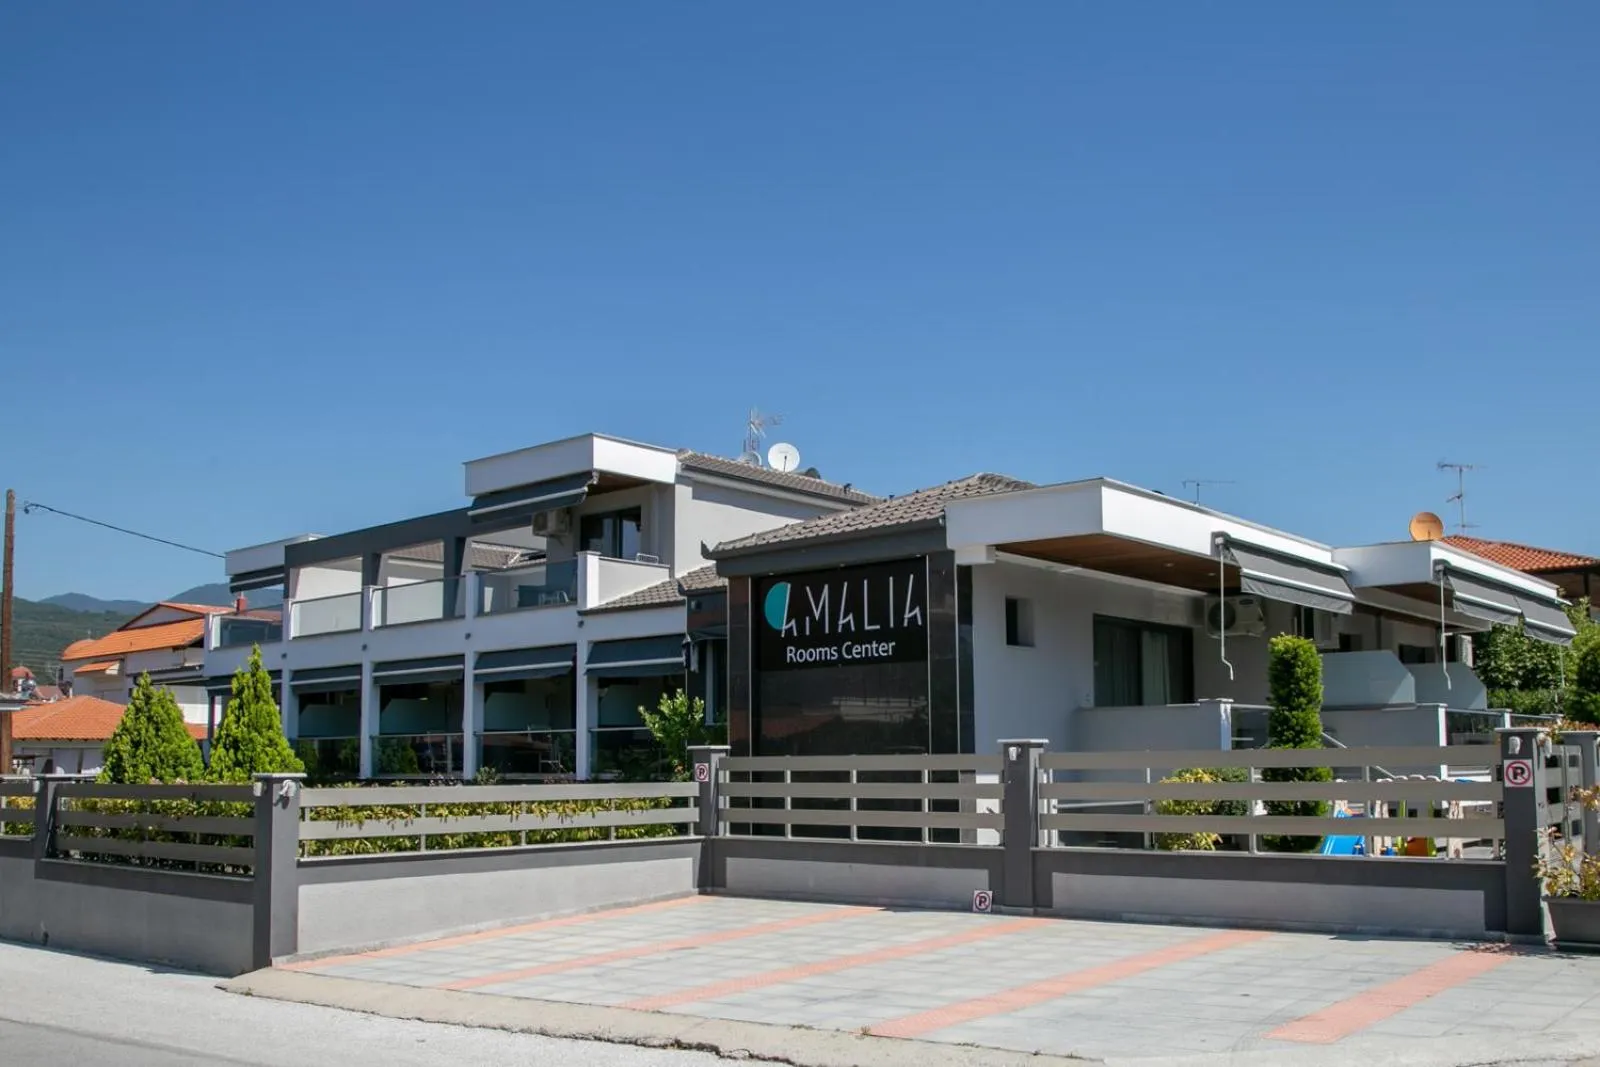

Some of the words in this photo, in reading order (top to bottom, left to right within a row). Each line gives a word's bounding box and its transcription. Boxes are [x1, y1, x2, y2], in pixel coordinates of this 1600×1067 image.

[780, 574, 923, 638] AMALIA
[786, 645, 838, 663] Rooms
[842, 641, 896, 659] Center
[1513, 766, 1526, 780] P
